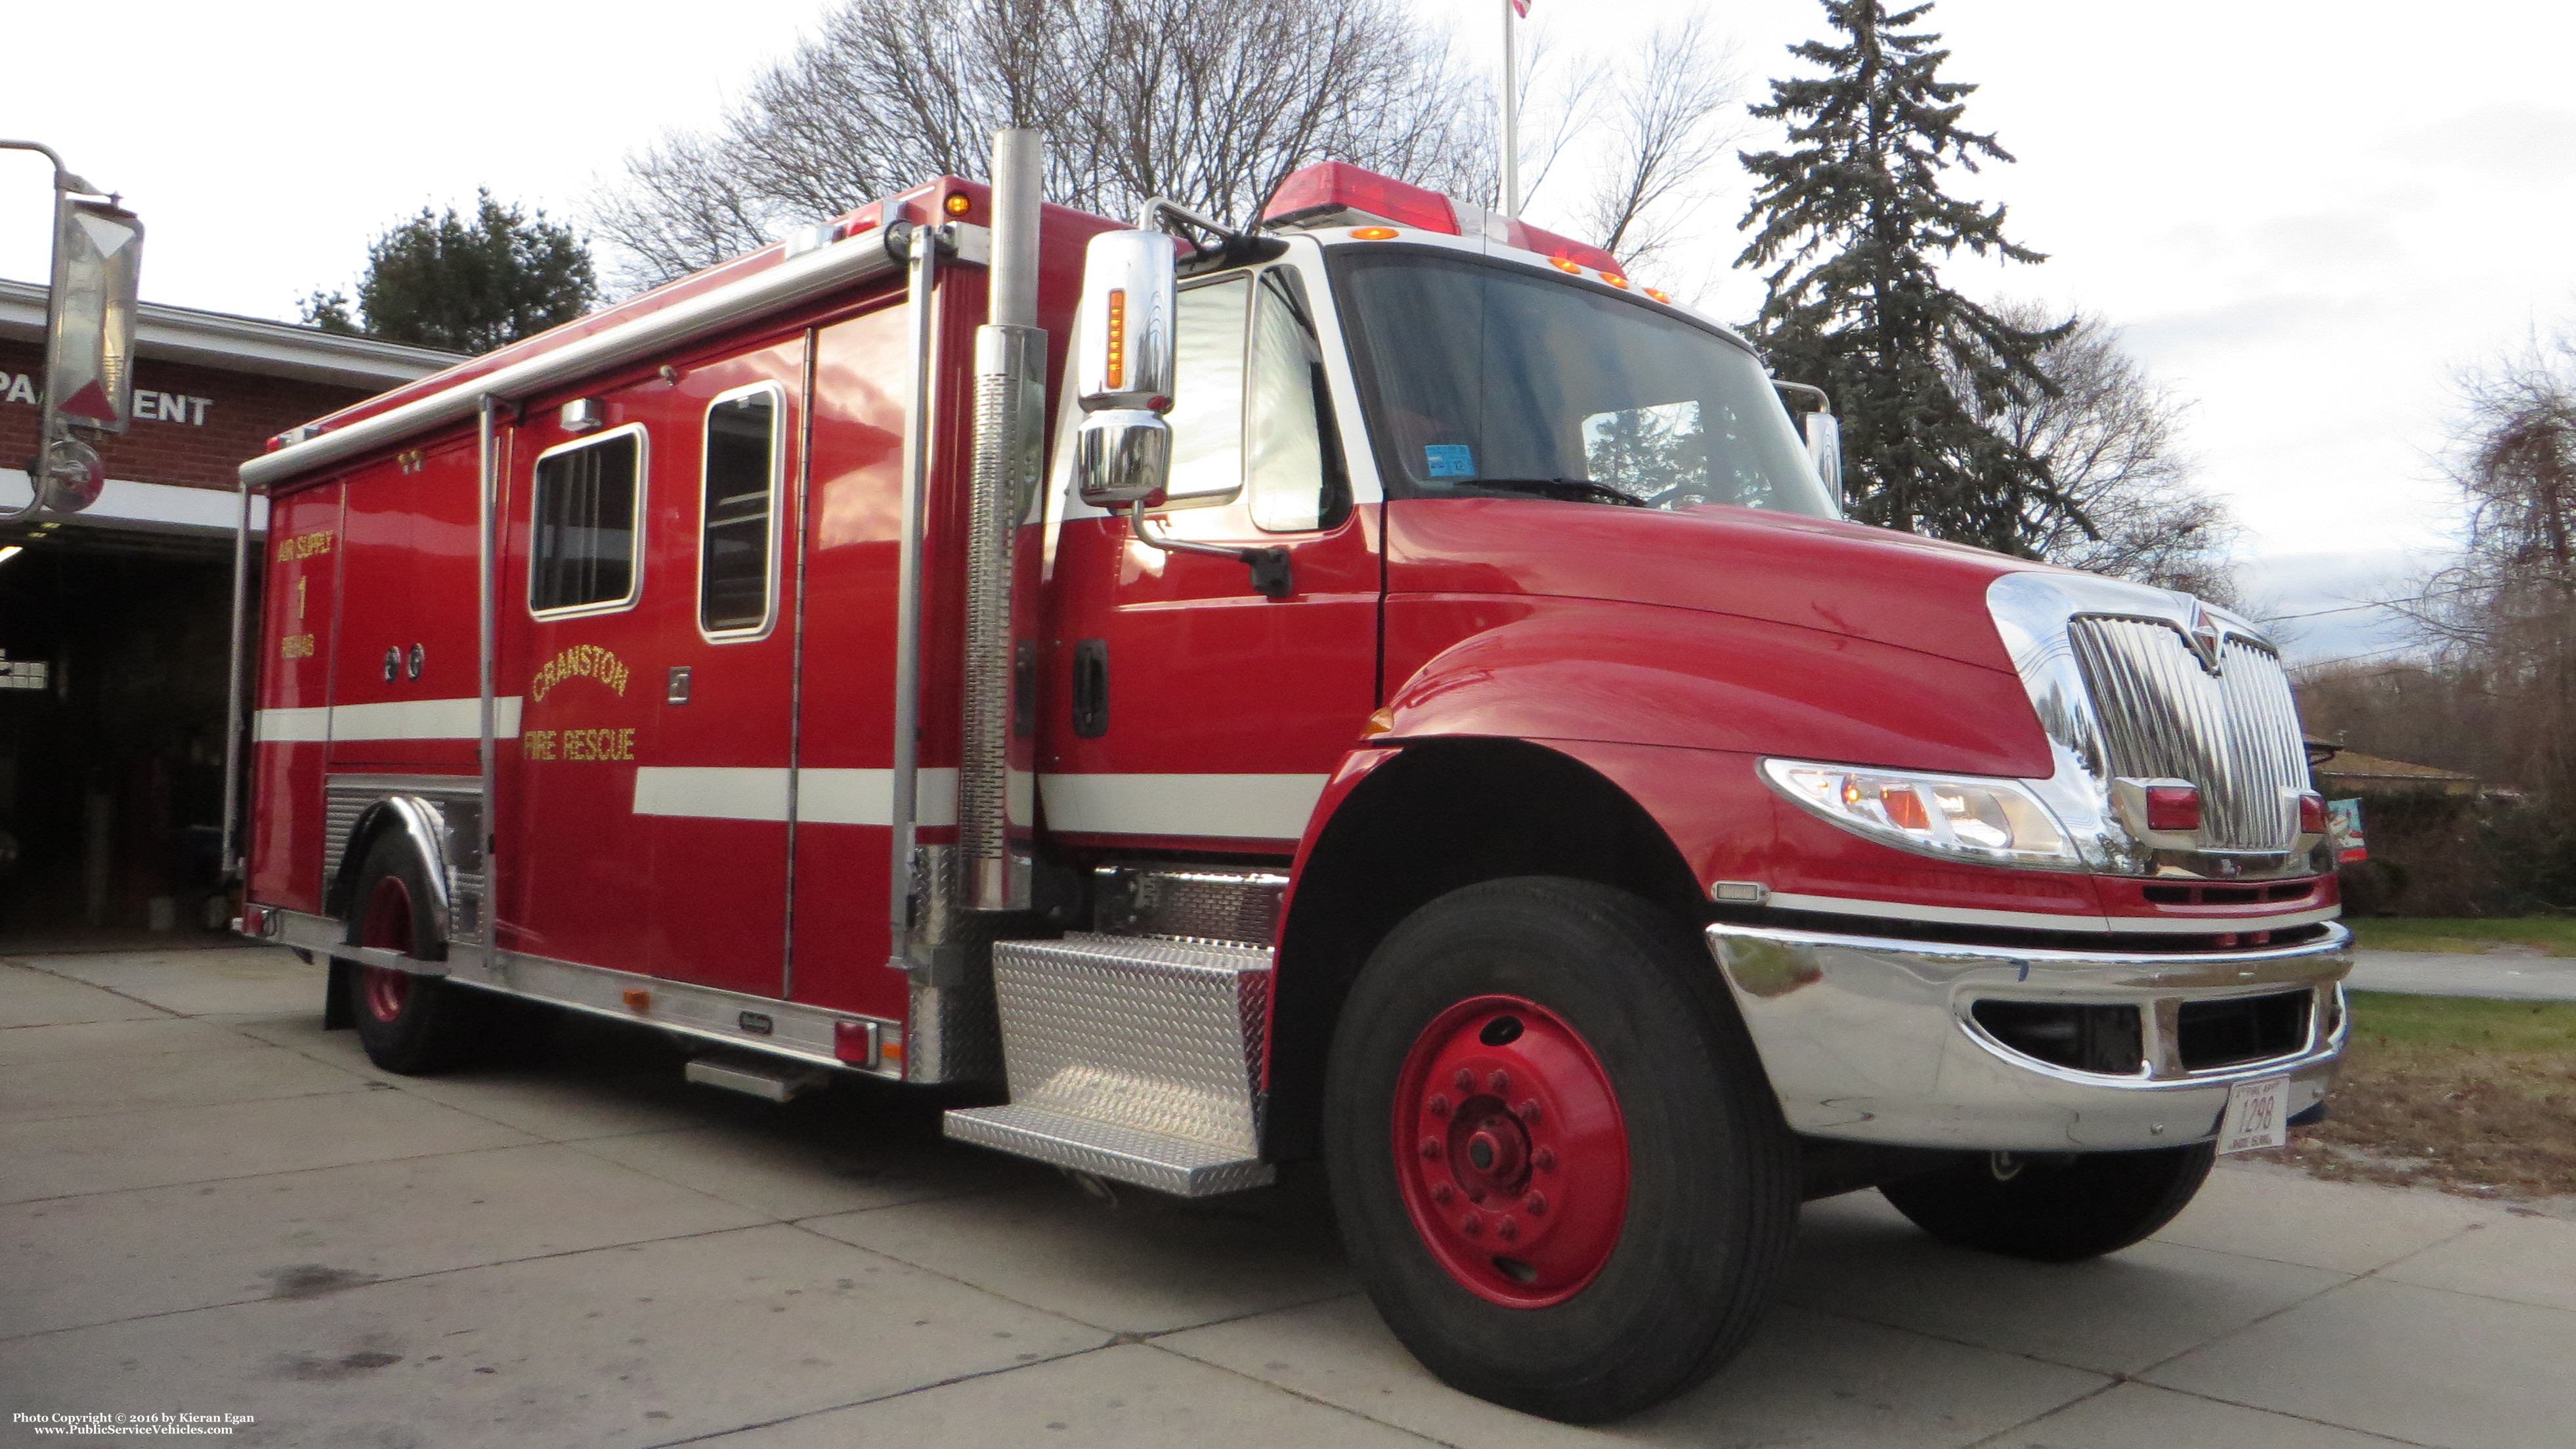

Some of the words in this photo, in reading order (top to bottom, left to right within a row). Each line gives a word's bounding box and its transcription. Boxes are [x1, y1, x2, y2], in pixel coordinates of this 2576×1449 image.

[296, 530, 333, 559] SUPPLY
[297, 575, 307, 619] 1
[532, 644, 630, 703] CRANSTON
[525, 730, 557, 760] FIRE
[563, 728, 635, 760] RESCUE
